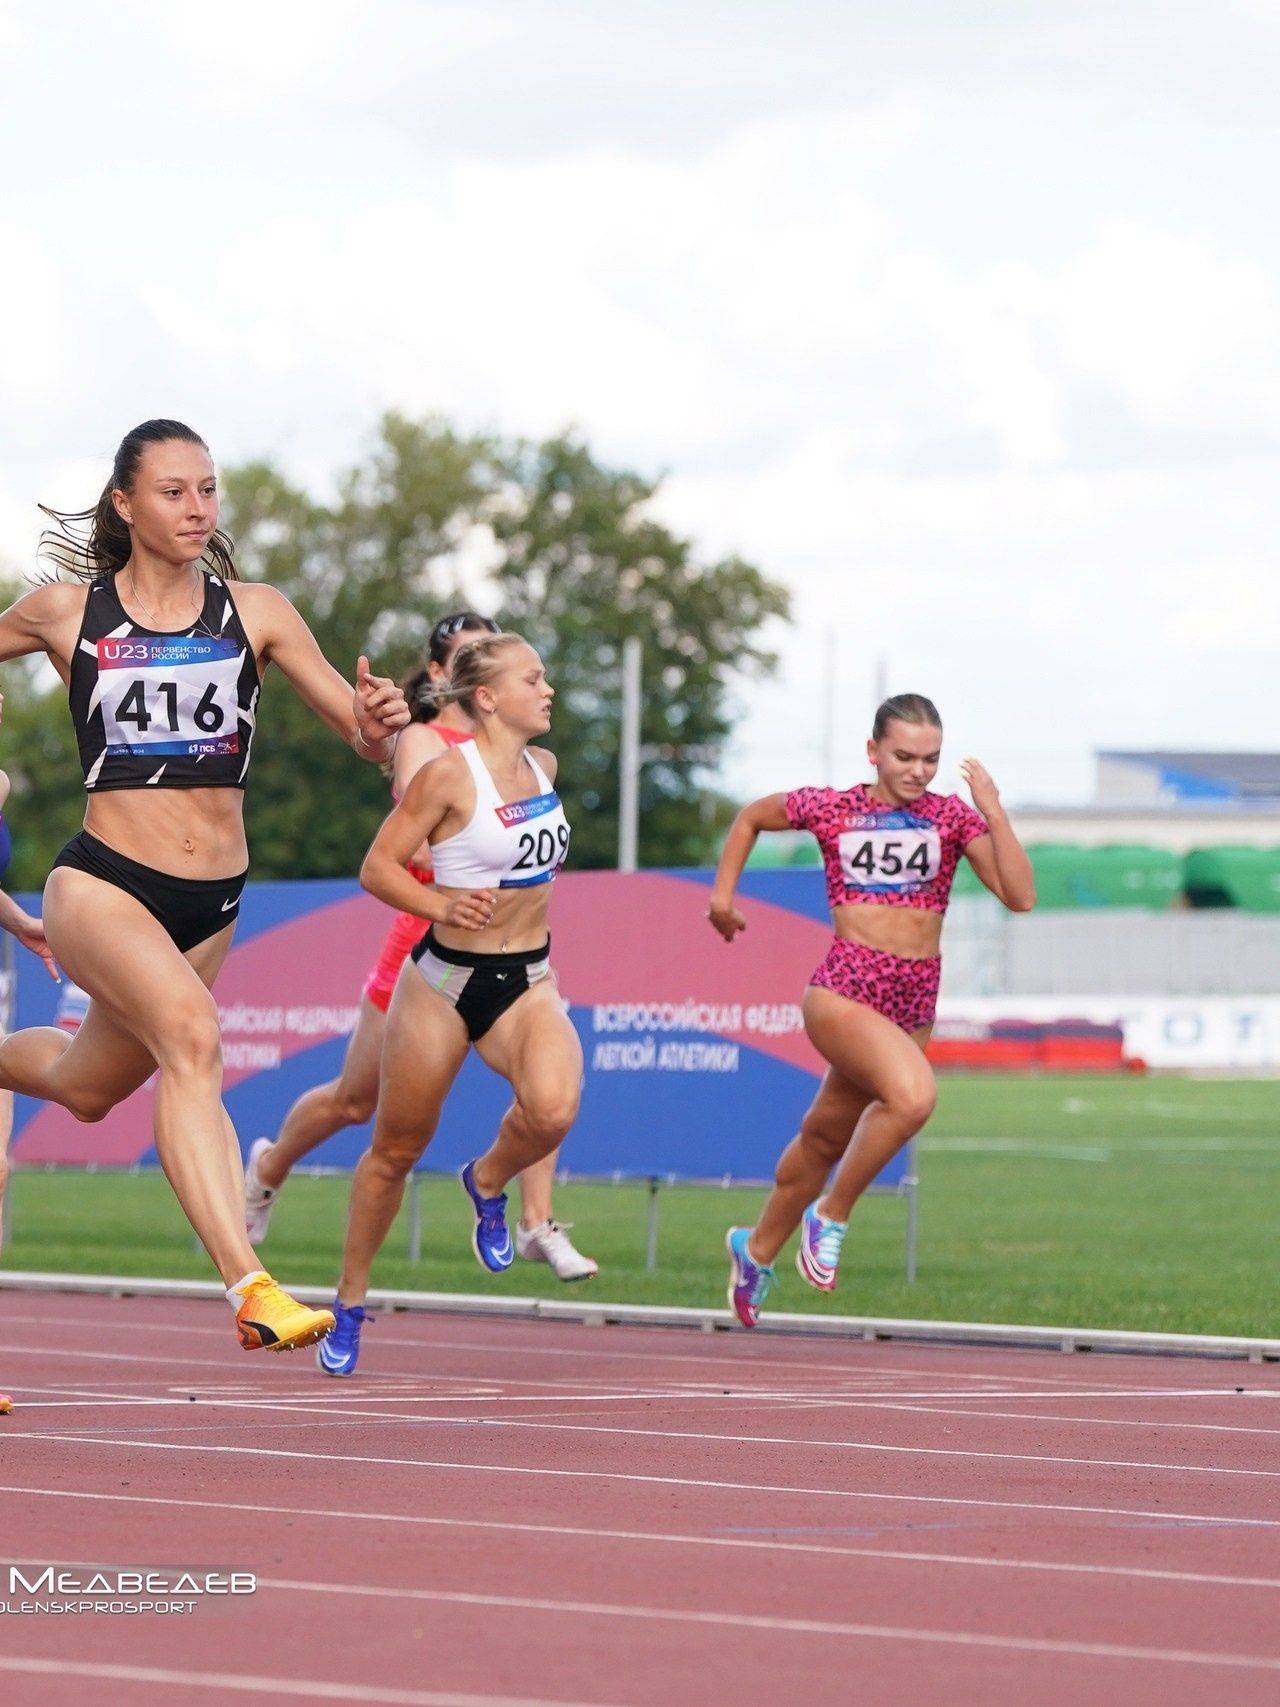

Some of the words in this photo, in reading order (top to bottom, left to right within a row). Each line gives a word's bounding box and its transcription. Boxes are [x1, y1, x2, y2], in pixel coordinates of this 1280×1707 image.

[104, 644, 149, 660] U23
[151, 646, 211, 654] ПЕРВЕНСТВО
[151, 652, 190, 660] РОССИИ
[115, 680, 224, 733] 416
[500, 805, 526, 821] U23
[844, 815, 877, 828] U23
[511, 824, 569, 871] 209
[851, 841, 930, 877] 454
[592, 997, 742, 1033] ВСЕРОССИЙСКАЯ
[745, 1003, 805, 1037] ФЕДЕР
[592, 1035, 656, 1072] ЛЕГКОЙ
[657, 1041, 739, 1073] АТЛЕТИКИ
